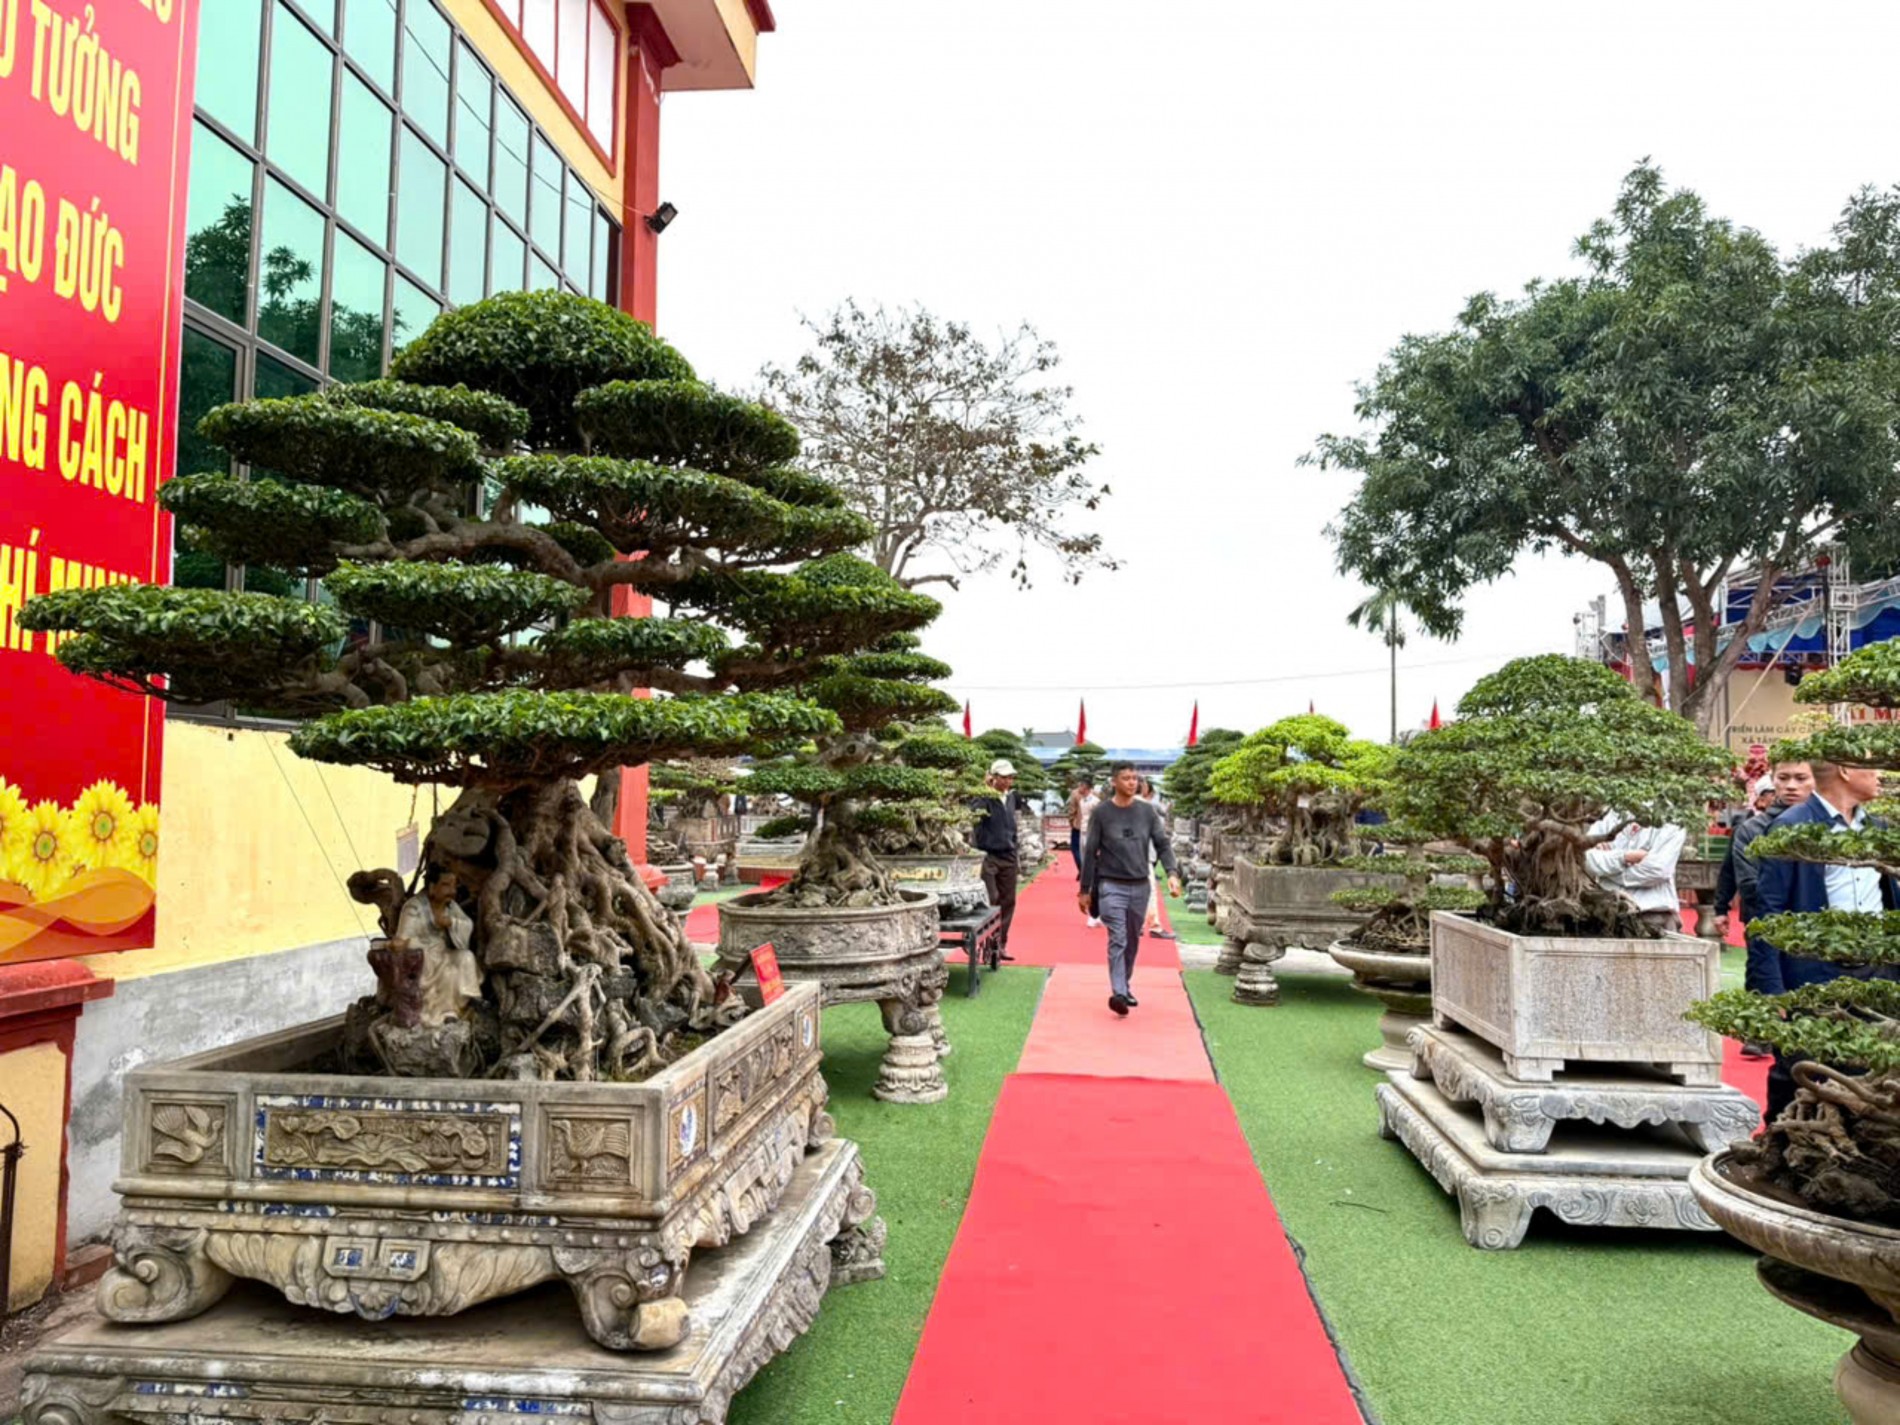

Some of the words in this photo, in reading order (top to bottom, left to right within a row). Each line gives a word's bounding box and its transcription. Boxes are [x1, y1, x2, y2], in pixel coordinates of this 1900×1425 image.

[31, 0, 141, 166] TƯỞNG
[0, 164, 45, 292] ẠO
[54, 195, 124, 323] ĐỨC
[0, 351, 48, 471] NG
[58, 370, 148, 504] CÁCH
[0, 527, 41, 652] HÍ
